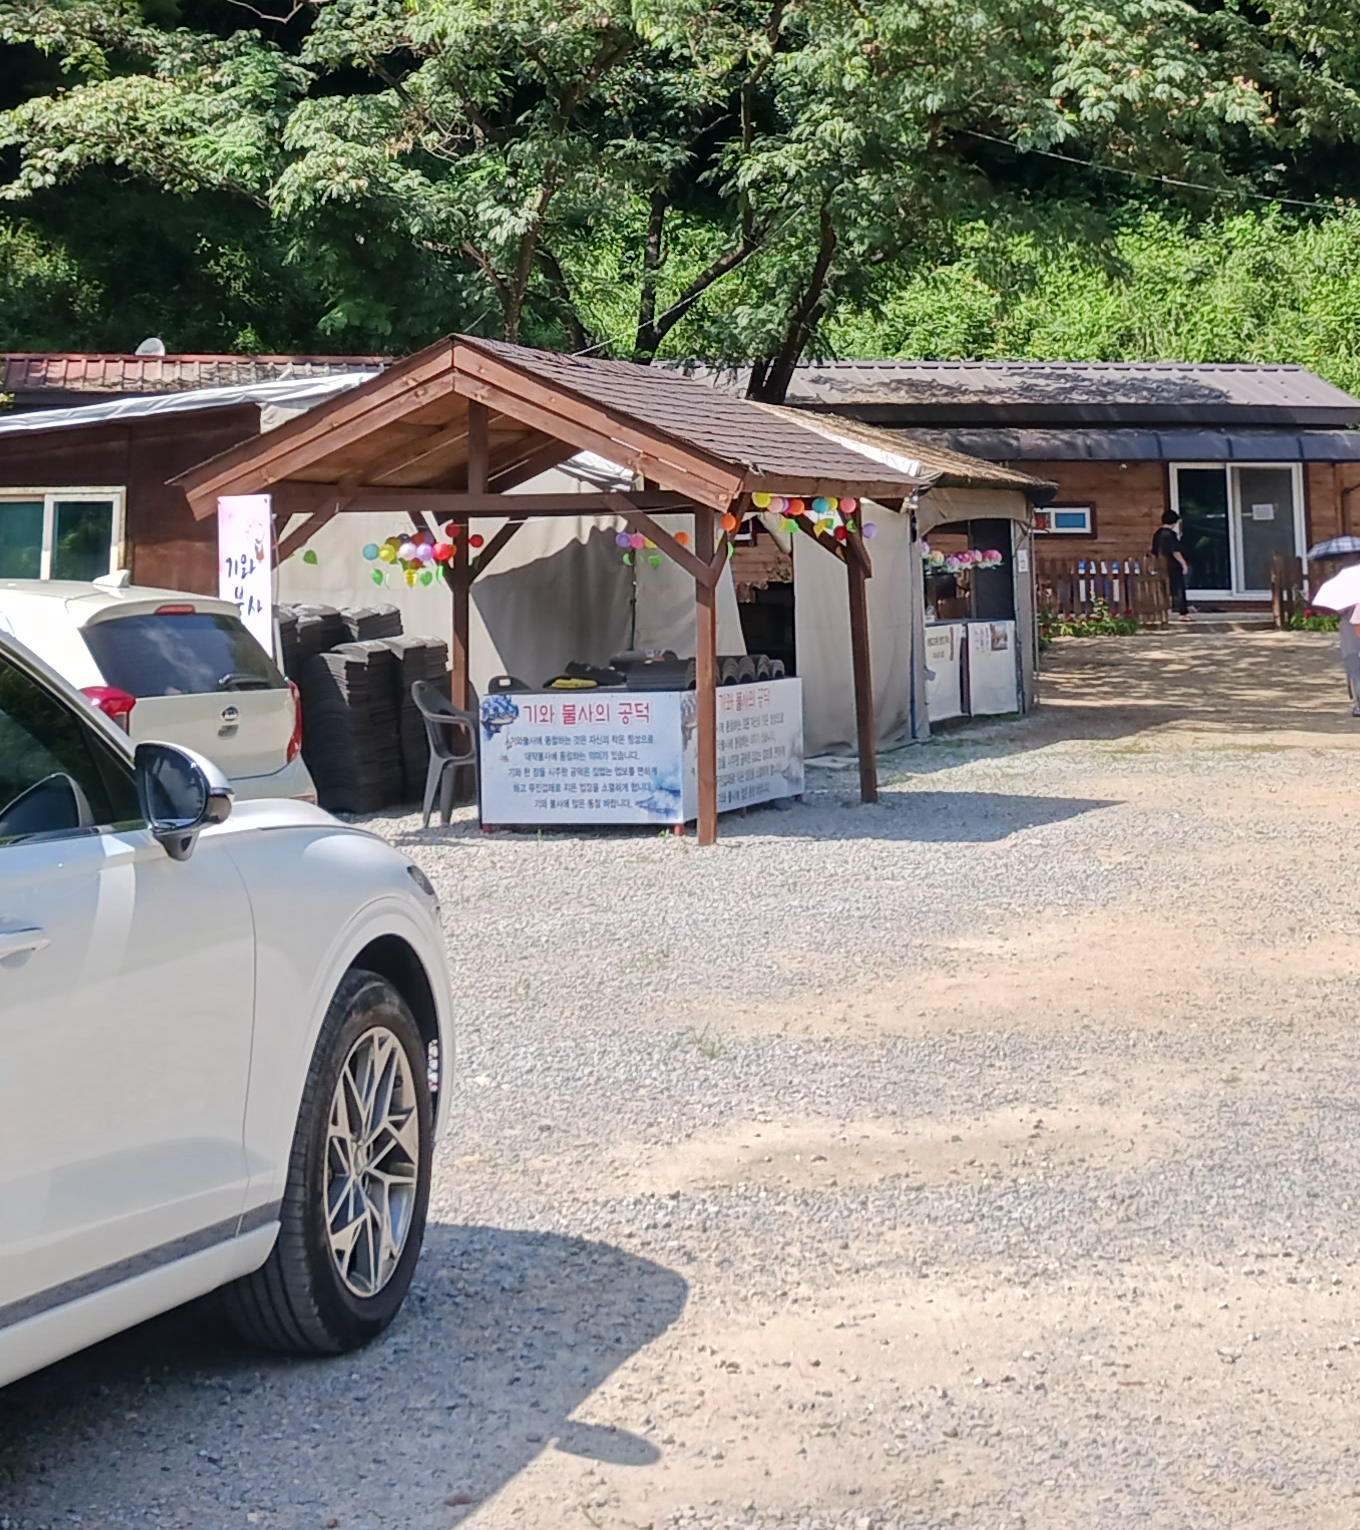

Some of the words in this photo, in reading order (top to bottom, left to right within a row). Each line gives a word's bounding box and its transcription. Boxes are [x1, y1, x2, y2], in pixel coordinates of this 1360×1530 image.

[225, 554, 256, 579] 기와
[523, 704, 555, 724] 기와
[562, 703, 610, 725] 불사의
[618, 702, 649, 725] 공덕
